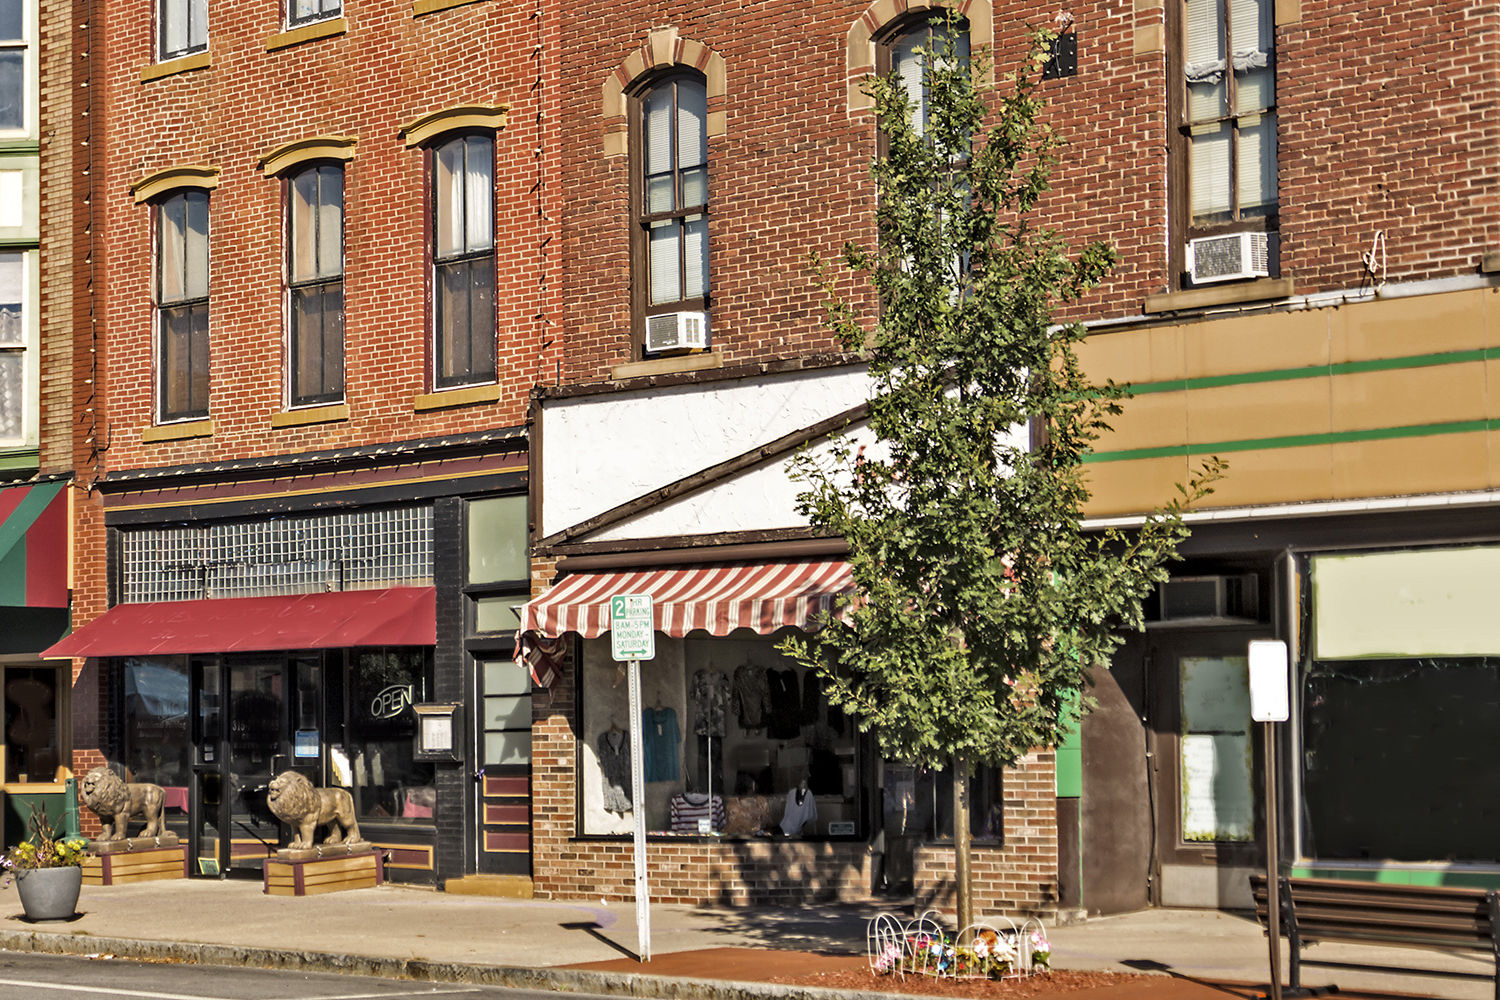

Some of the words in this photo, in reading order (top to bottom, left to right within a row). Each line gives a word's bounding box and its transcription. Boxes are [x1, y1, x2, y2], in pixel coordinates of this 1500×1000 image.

[632, 598, 643, 606] HR
[615, 599, 625, 617] 2
[625, 608, 650, 616] PARKING
[616, 640, 650, 649] SATURDAY
[371, 684, 414, 717] OPEN
